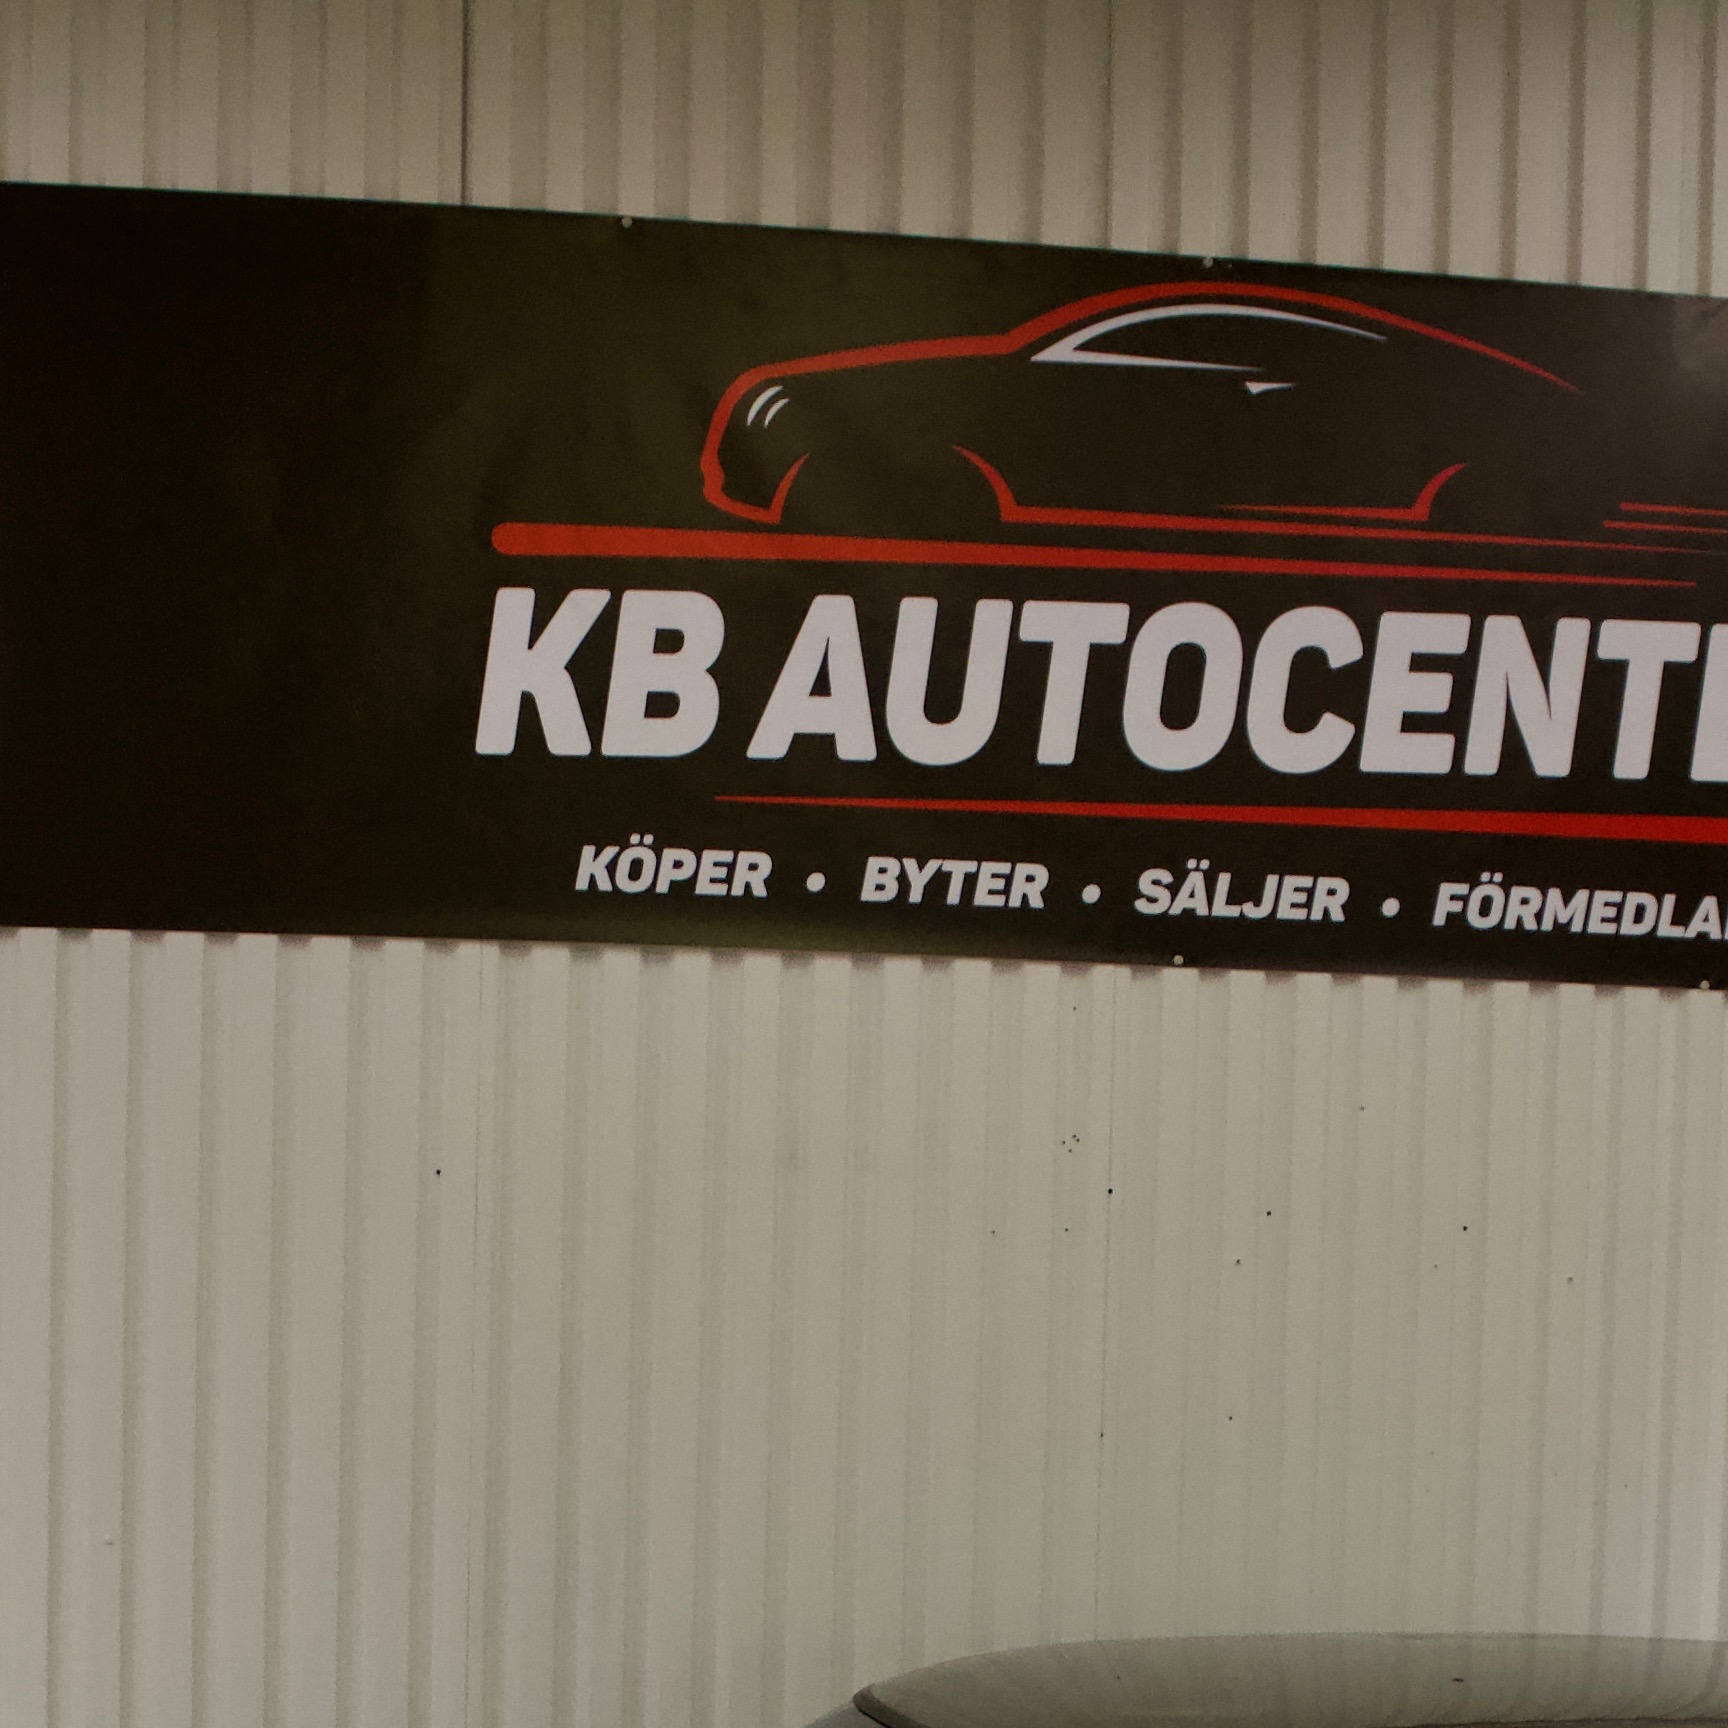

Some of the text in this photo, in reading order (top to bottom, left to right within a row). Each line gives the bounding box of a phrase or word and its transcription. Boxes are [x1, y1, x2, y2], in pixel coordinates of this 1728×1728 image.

[474, 587, 725, 758] KB
[574, 833, 773, 898] KÖPER
[860, 856, 1050, 909] BYTER
[1134, 860, 1350, 923] SÄLJER
